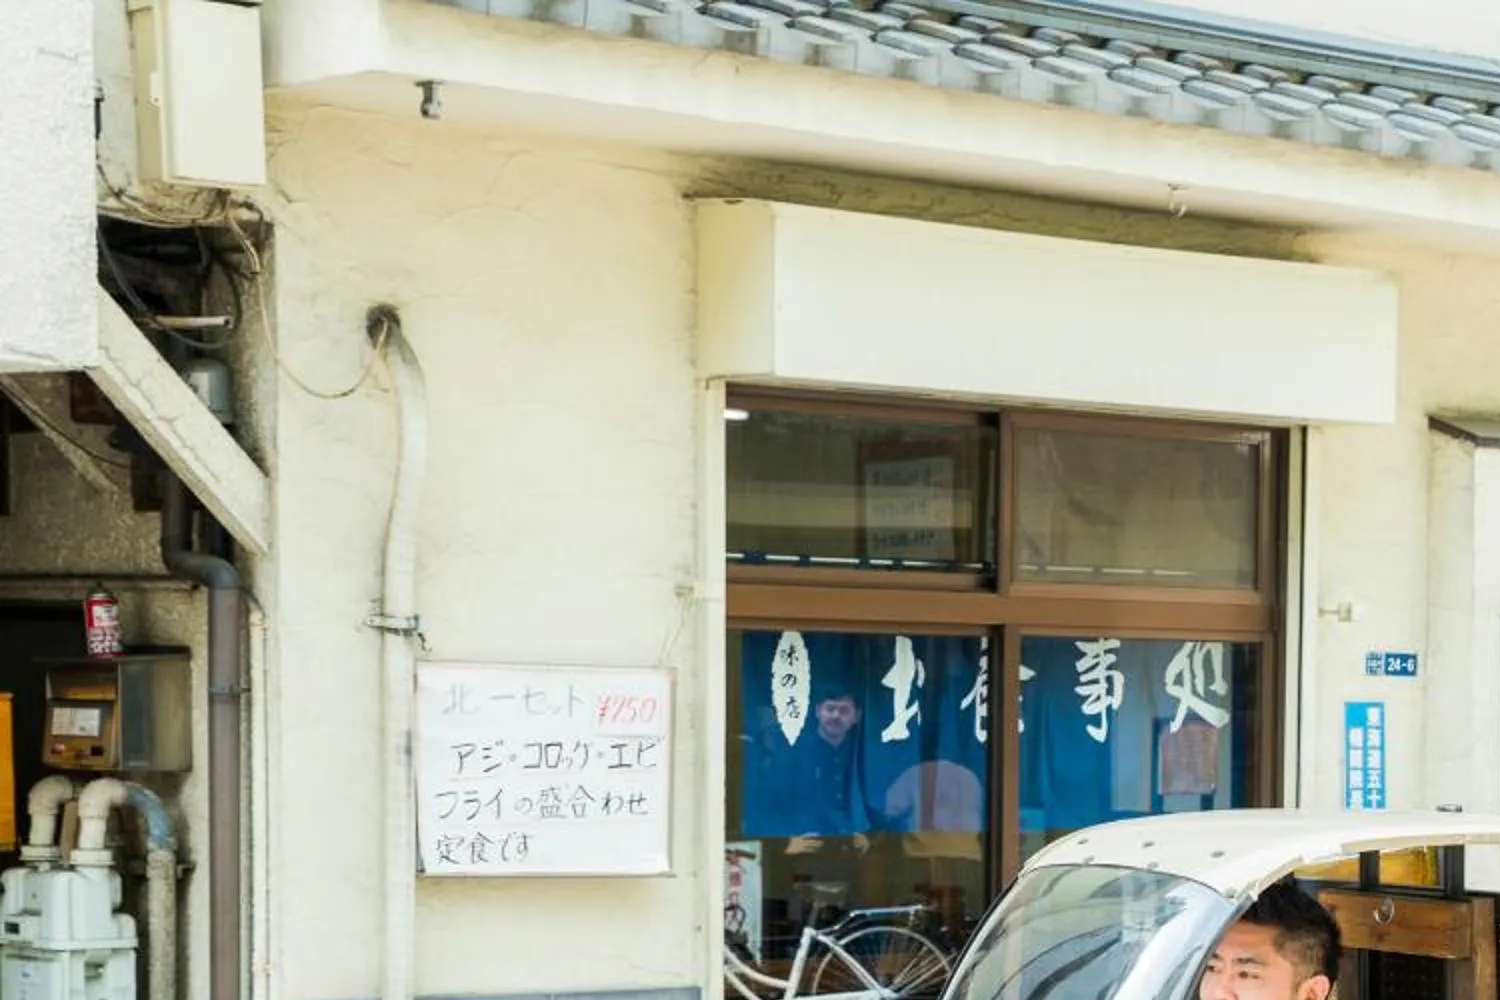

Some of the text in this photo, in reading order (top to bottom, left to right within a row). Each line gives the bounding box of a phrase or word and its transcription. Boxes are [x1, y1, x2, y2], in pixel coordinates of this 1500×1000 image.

[1387, 656, 1415, 673] 24-6
[778, 645, 801, 720] 味の店
[436, 831, 534, 865] 定食です
